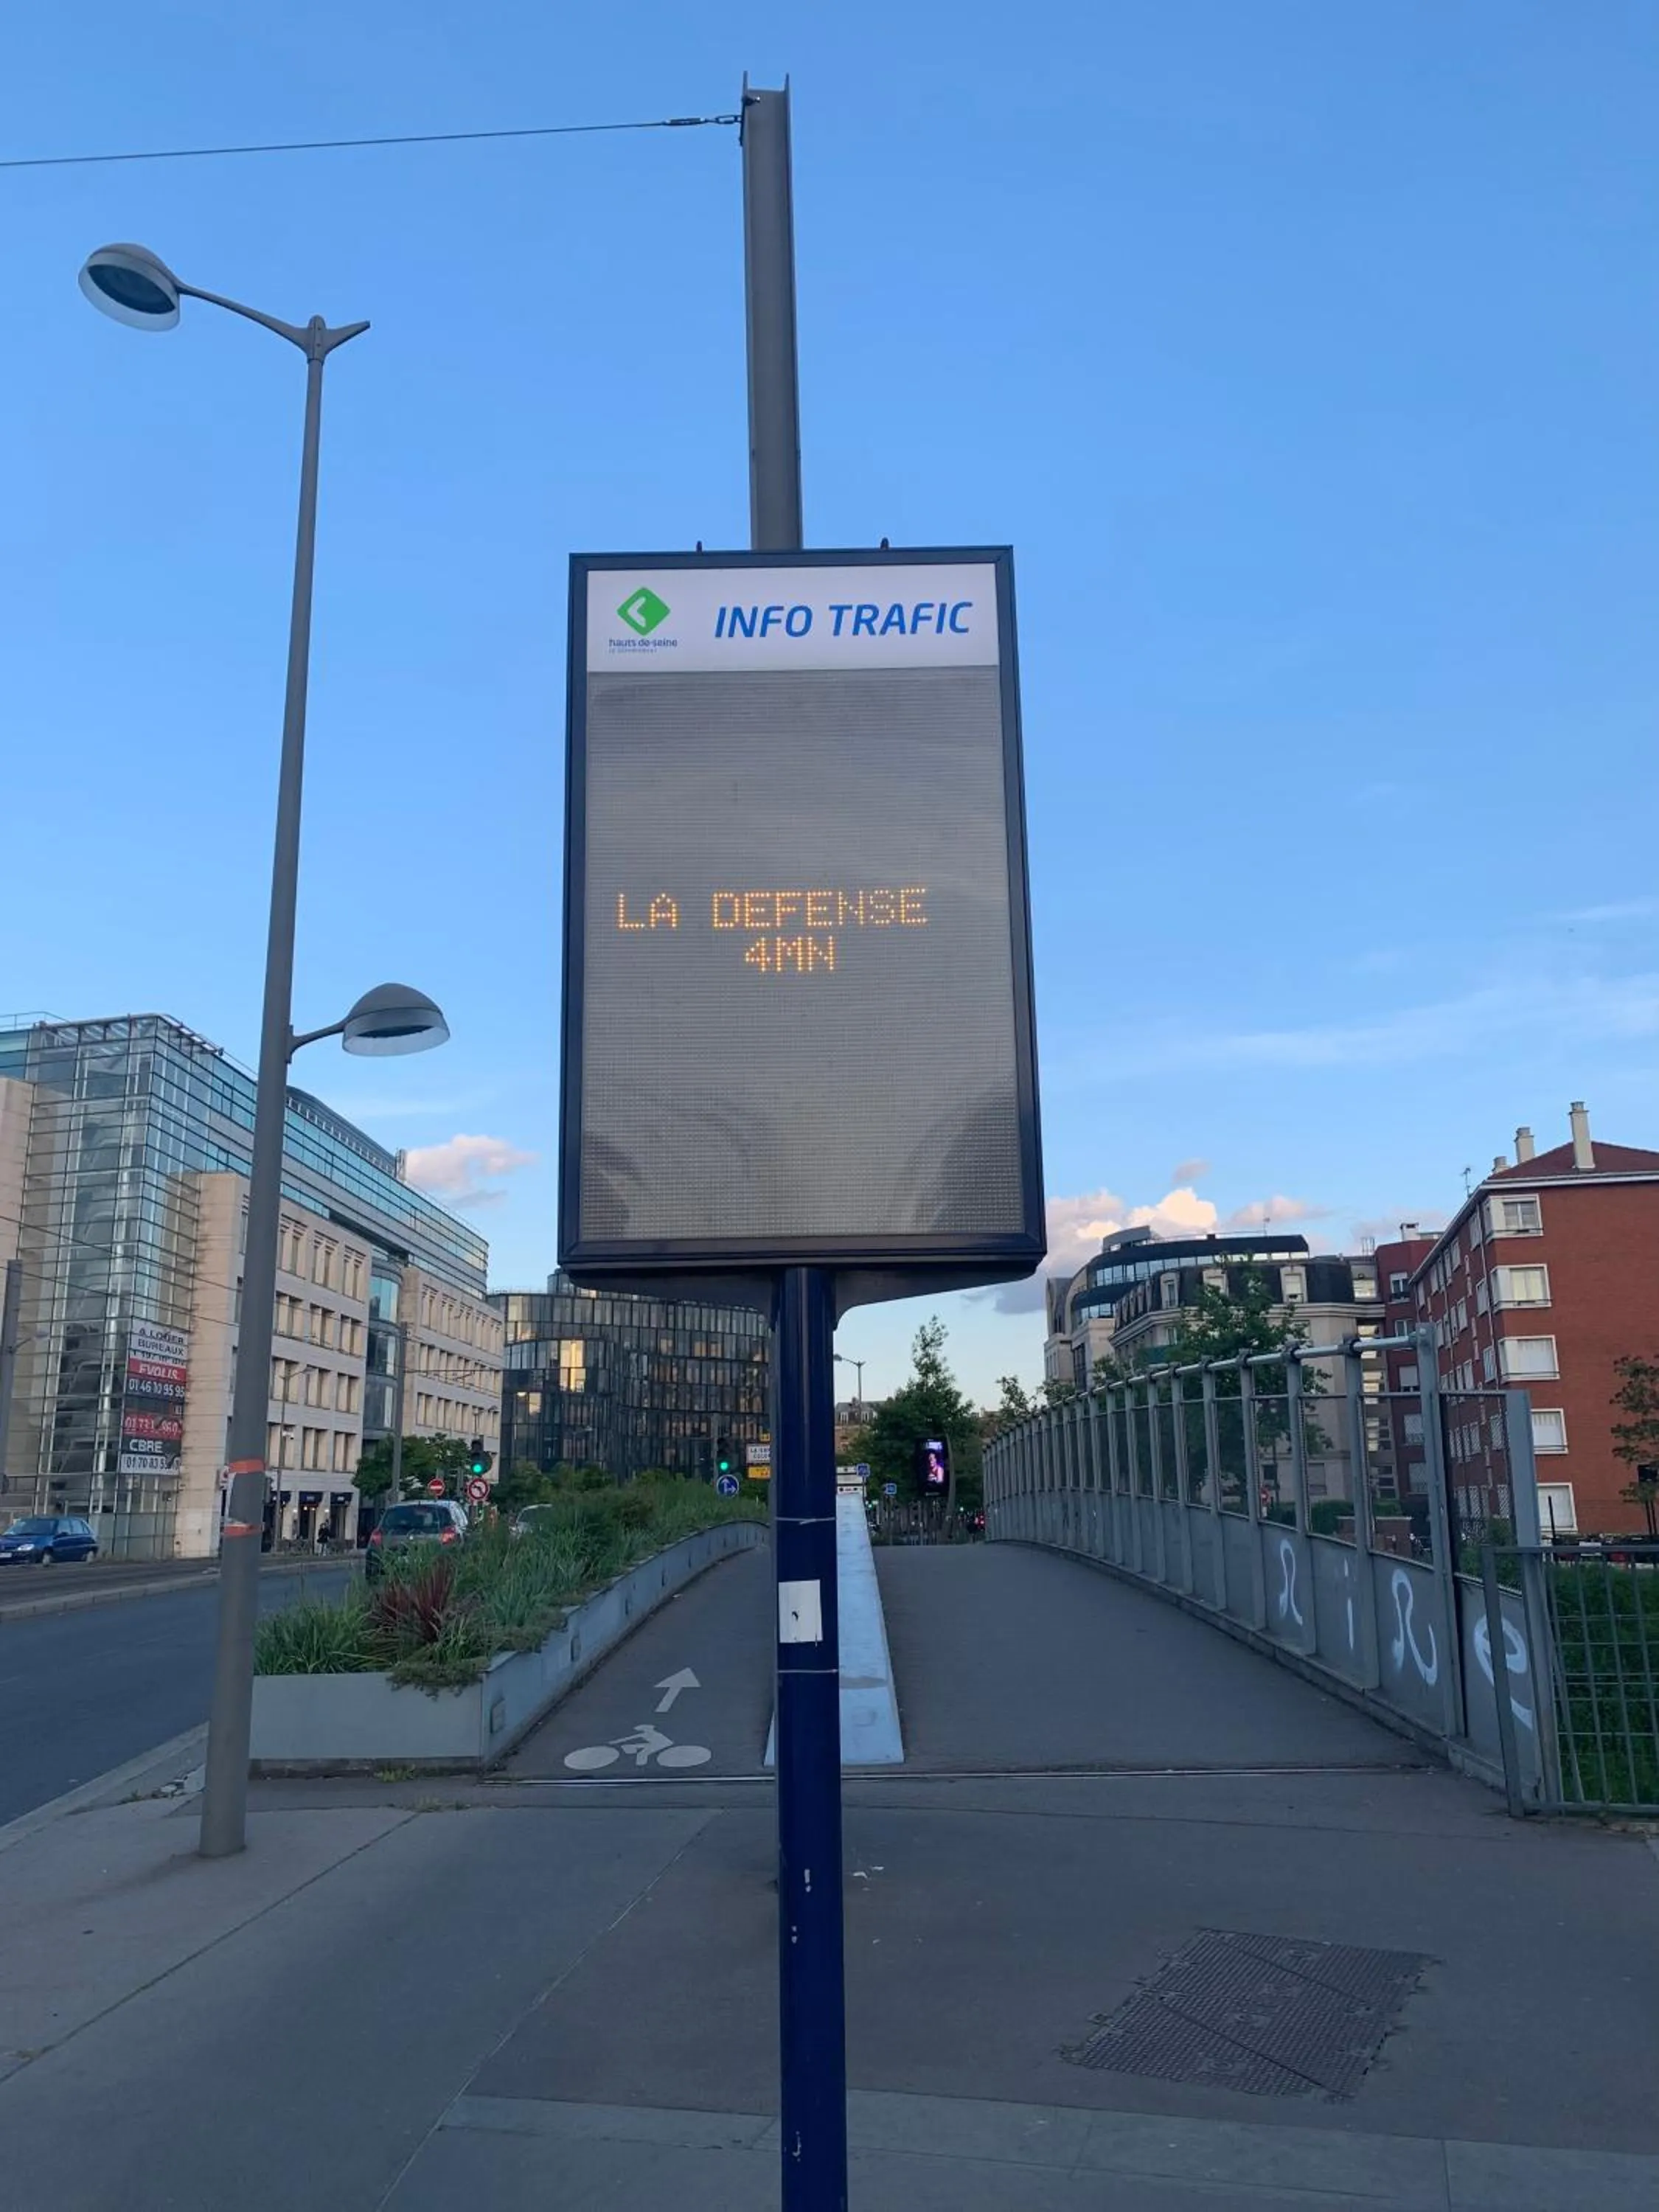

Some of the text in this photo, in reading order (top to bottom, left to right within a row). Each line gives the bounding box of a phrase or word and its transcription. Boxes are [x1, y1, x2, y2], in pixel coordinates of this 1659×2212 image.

[714, 601, 973, 639] INFO TRAFIC
[616, 887, 928, 928] LA DEFENSE
[745, 935, 836, 972] 4MN
[138, 1338, 184, 1356] BUREAUX
[129, 1439, 164, 1453] CBRE
